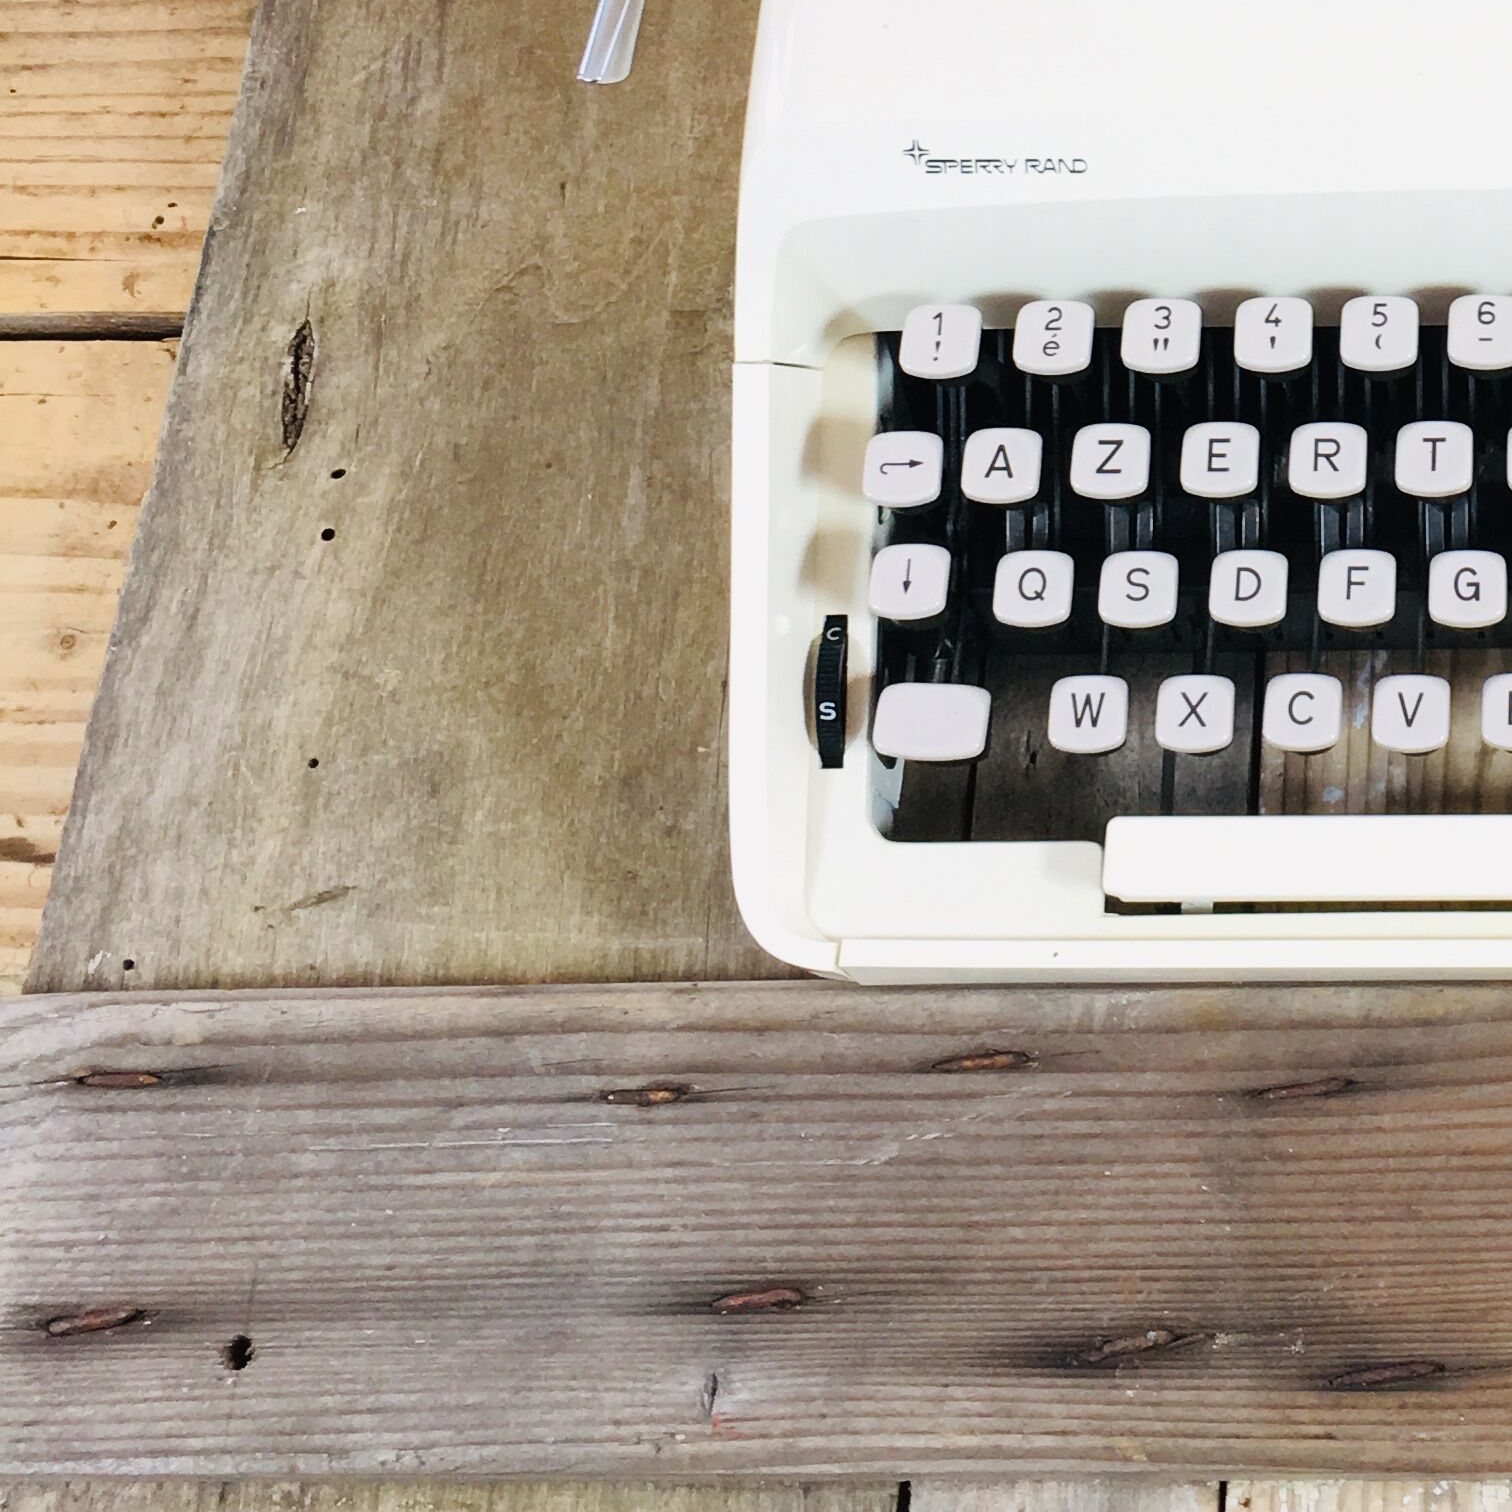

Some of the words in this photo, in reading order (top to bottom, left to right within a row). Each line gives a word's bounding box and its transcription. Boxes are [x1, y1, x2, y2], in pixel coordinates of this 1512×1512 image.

[925, 159, 1017, 174] SPERRY
[1025, 158, 1088, 174] RAND
[933, 312, 942, 335] 1
[1045, 307, 1062, 330] 2
[1155, 306, 1171, 329] 3
[1265, 304, 1281, 327] 4
[1372, 304, 1387, 327] 5
[1478, 302, 1495, 324] 6
[933, 340, 941, 362] !
[1043, 334, 1059, 356] é
[1152, 337, 1170, 351] "
[1374, 334, 1382, 350] (
[985, 445, 1013, 478] A
[1096, 440, 1123, 473] Z
[1208, 439, 1230, 472] E
[1314, 439, 1340, 471] R
[1423, 438, 1446, 471] T
[1019, 568, 1046, 600] Q
[1126, 568, 1149, 601] S
[1235, 567, 1261, 601] D
[1347, 566, 1369, 600] F
[1454, 568, 1479, 601] G
[827, 628, 840, 640] C
[820, 702, 836, 720] S
[1072, 693, 1105, 727] W
[1179, 692, 1207, 727] X
[1288, 691, 1314, 725] C
[1398, 693, 1423, 727] V
